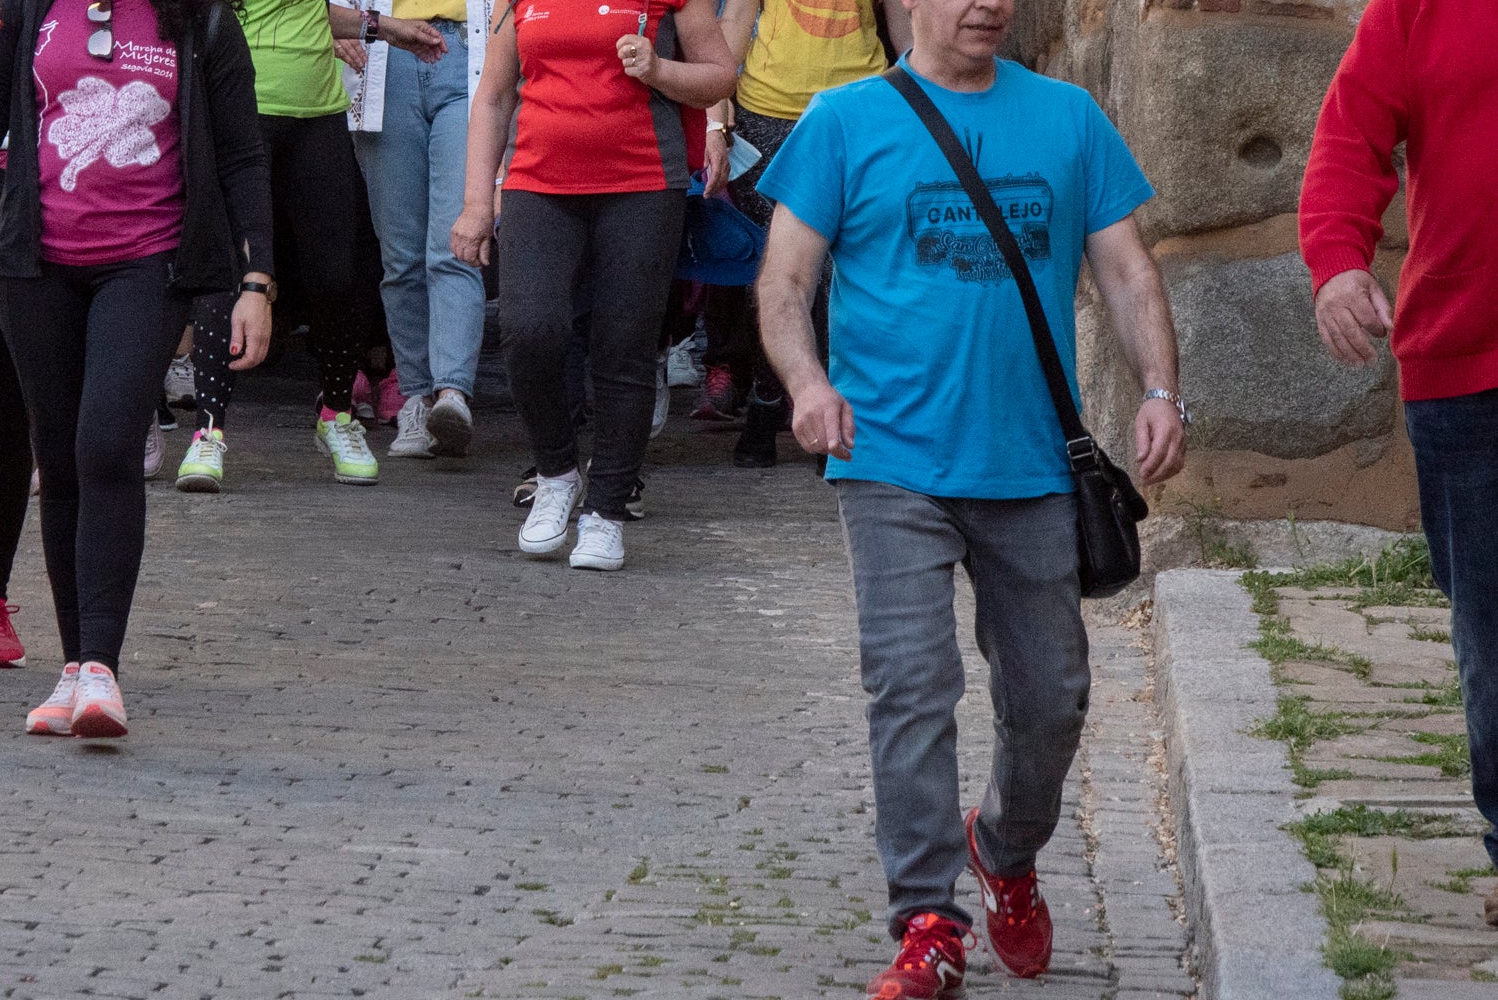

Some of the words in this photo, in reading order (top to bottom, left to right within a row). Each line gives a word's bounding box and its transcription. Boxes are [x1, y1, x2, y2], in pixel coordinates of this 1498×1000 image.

[113, 40, 163, 54] Marcha
[166, 47, 177, 57] de
[119, 51, 176, 68] Mujeres
[927, 201, 1043, 224] CANTLEJO
